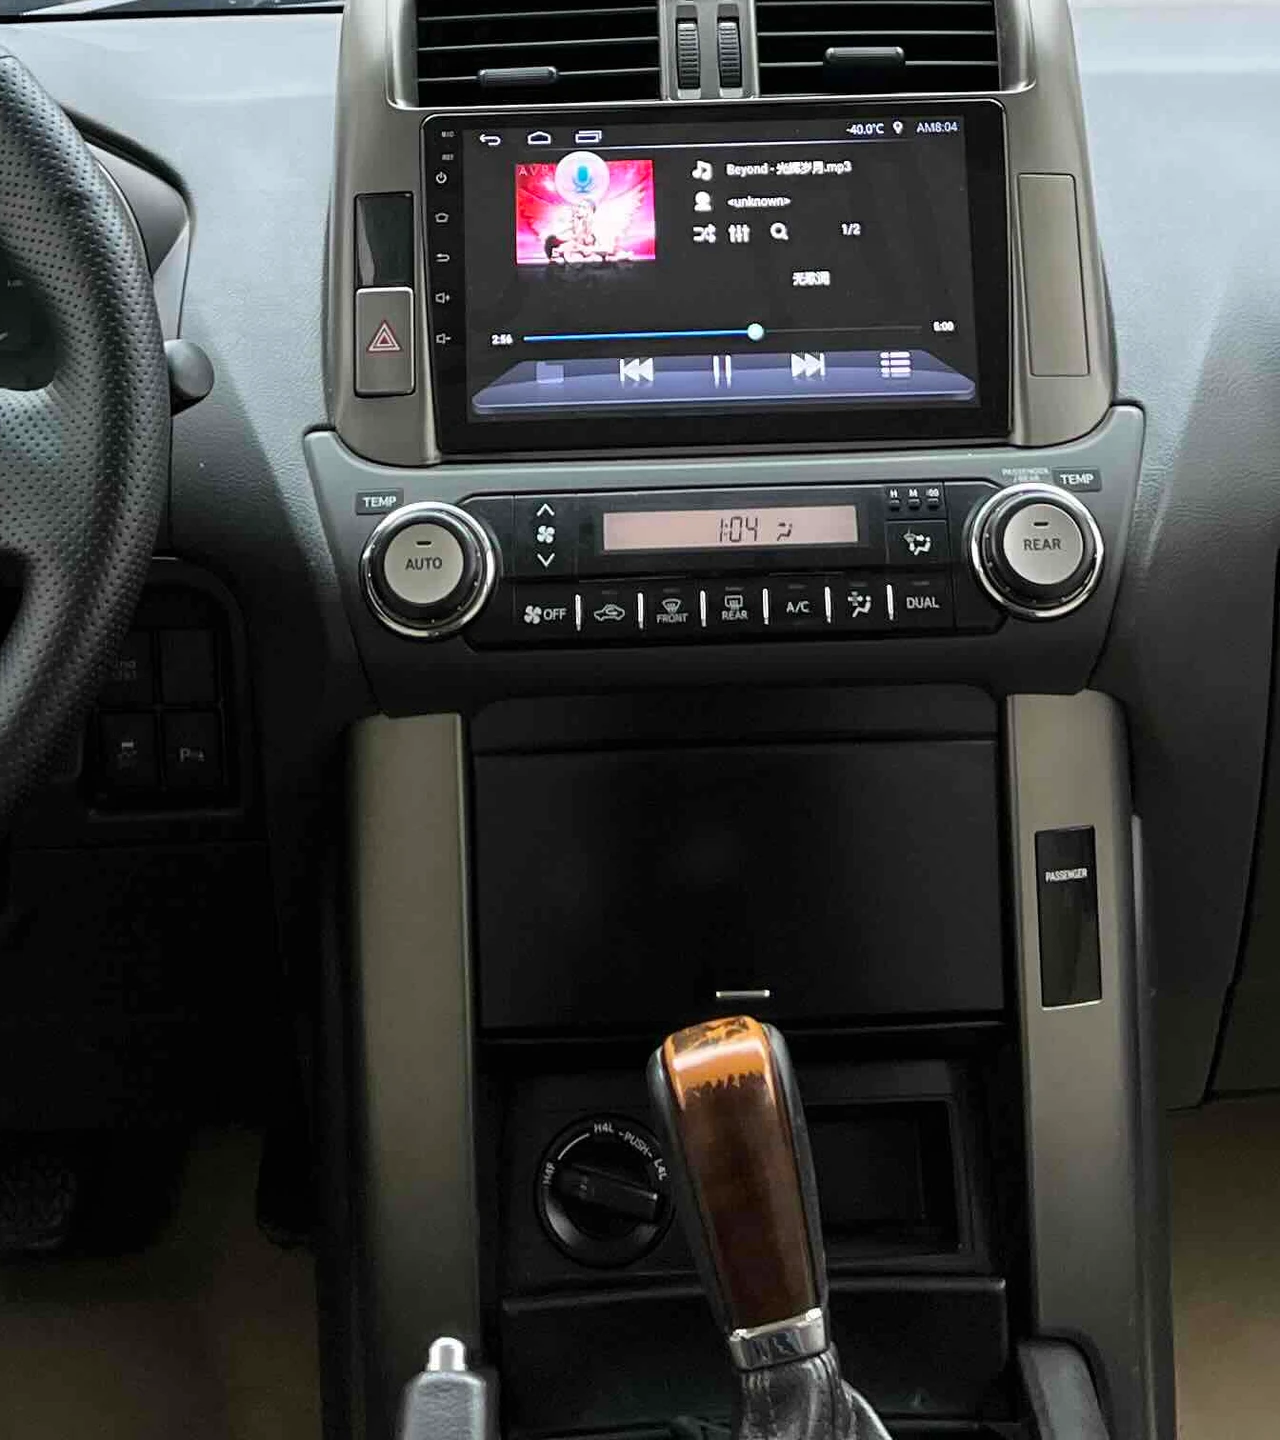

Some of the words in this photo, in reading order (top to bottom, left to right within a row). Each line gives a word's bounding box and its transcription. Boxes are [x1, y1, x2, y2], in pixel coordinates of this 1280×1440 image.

[916, 121, 959, 134] AM8:04
[726, 162, 769, 177] Beyond
[727, 195, 791, 208] <unknown>
[841, 223, 861, 236] 1/2
[1059, 472, 1095, 485] TEMP
[363, 496, 397, 508] TEMP
[720, 516, 759, 542] 1:04
[1023, 538, 1061, 551] REAR
[405, 556, 443, 570] AUTO
[786, 602, 809, 613] A/C
[906, 597, 940, 609] DUAL
[543, 607, 566, 621] OFF
[656, 612, 688, 624] FRONT
[721, 610, 748, 621] REAR
[1045, 868, 1088, 882] PASSENGER
